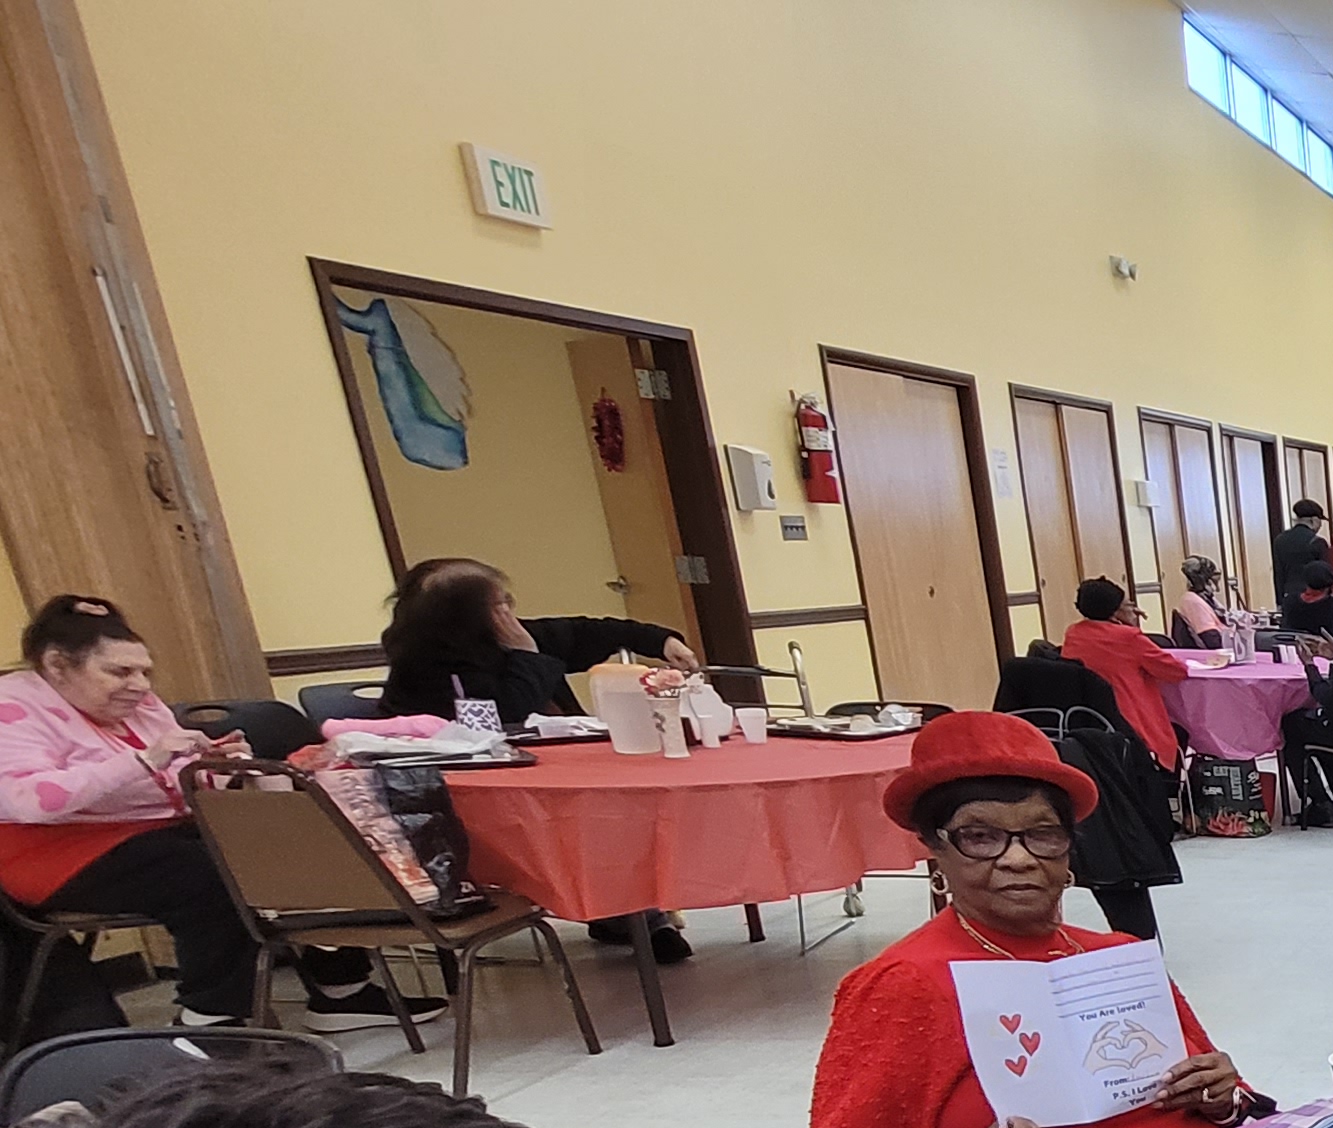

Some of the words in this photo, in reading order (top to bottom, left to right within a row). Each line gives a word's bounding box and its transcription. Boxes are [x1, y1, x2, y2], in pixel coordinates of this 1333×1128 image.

[489, 159, 540, 216] EXIT
[1079, 1012, 1097, 1021] You
[1100, 1008, 1115, 1017] Are
[1117, 1001, 1146, 1014] loved!
[1112, 1091, 1130, 1100] P.S.
[1137, 1082, 1157, 1094] Love
[1129, 1096, 1146, 1106] You
